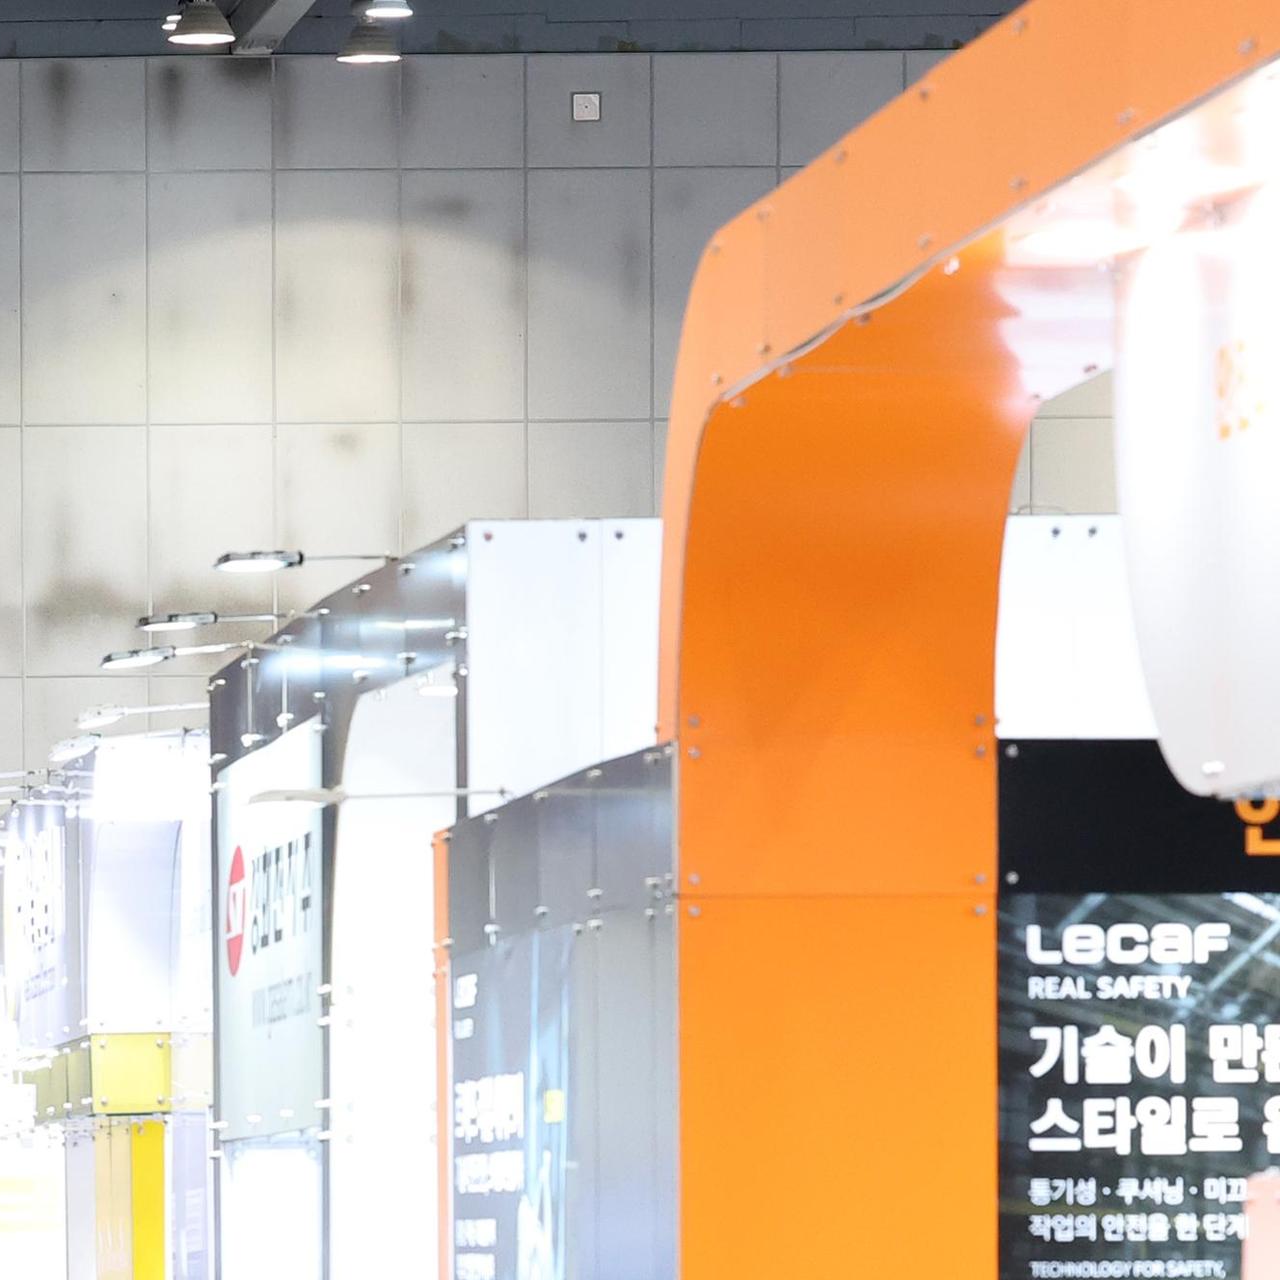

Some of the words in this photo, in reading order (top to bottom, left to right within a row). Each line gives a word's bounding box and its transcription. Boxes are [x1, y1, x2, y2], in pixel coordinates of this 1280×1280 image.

[1028, 975, 1093, 999] REAL
[1095, 975, 1192, 999] SAFETY
[1028, 1023, 1187, 1085] 기술이
[1028, 1096, 1243, 1156] 스타일로
[1203, 1176, 1248, 1205] 미끄
